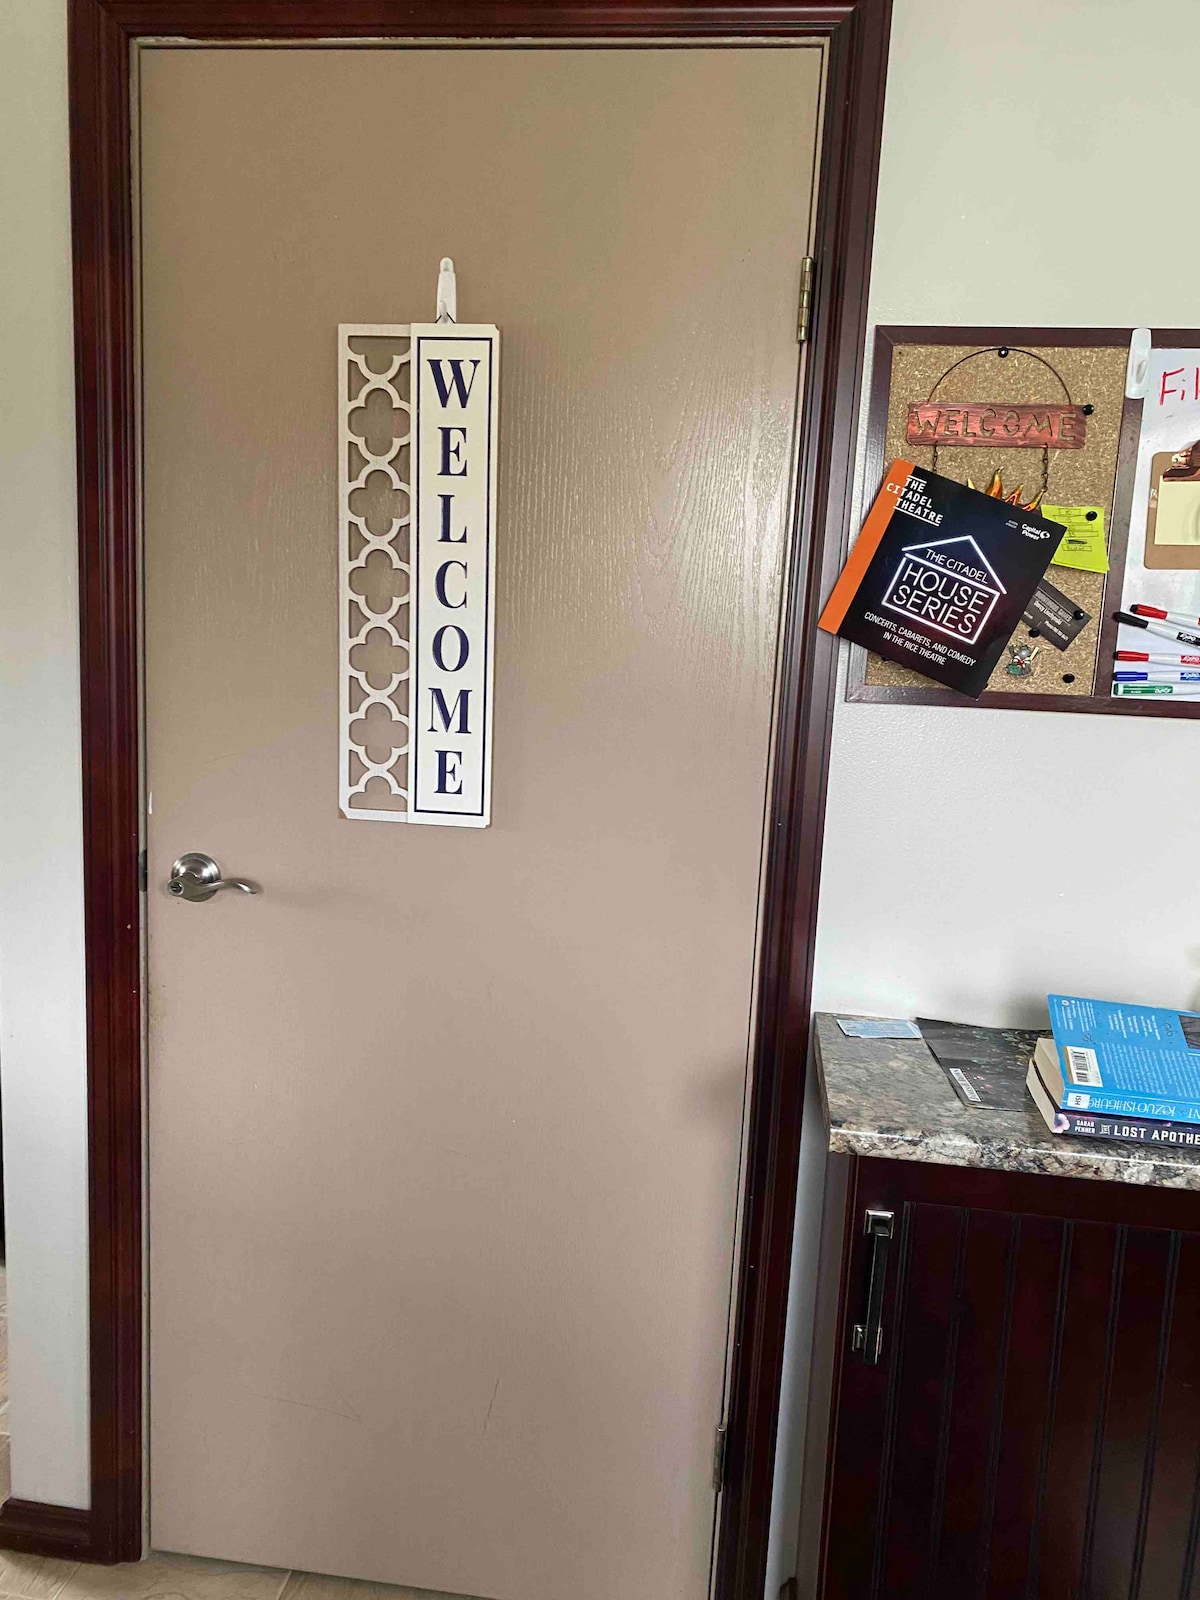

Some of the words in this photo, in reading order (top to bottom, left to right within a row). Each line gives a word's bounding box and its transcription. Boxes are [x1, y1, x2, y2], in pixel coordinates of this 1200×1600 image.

[914, 407, 1077, 442] WELCOME
[886, 482, 933, 508] CITADEL
[904, 477, 926, 493] THE
[895, 497, 943, 524] THEATRE
[1021, 523, 1042, 536] Capital
[1021, 529, 1040, 541] Power
[426, 358, 482, 796] WELCOME
[925, 548, 947, 565] THE
[946, 559, 989, 584] CITADEL
[902, 562, 989, 614] HOUSE
[893, 584, 976, 634] SERIES
[864, 611, 898, 633] CONCERTS,
[897, 626, 932, 648] CABARETS,
[931, 642, 948, 654] AND
[947, 648, 977, 667] COMEDY
[882, 631, 891, 640] IN
[891, 635, 905, 647] THE
[903, 640, 919, 653] RICE
[919, 647, 947, 666] THEATRE
[1074, 1095, 1082, 1106] ISH
[1137, 1102, 1176, 1117] KAZUO
[1076, 1119, 1095, 1128] SARAH
[1113, 1124, 1147, 1139] LOST
[1151, 1129, 1200, 1146] APOTHE
